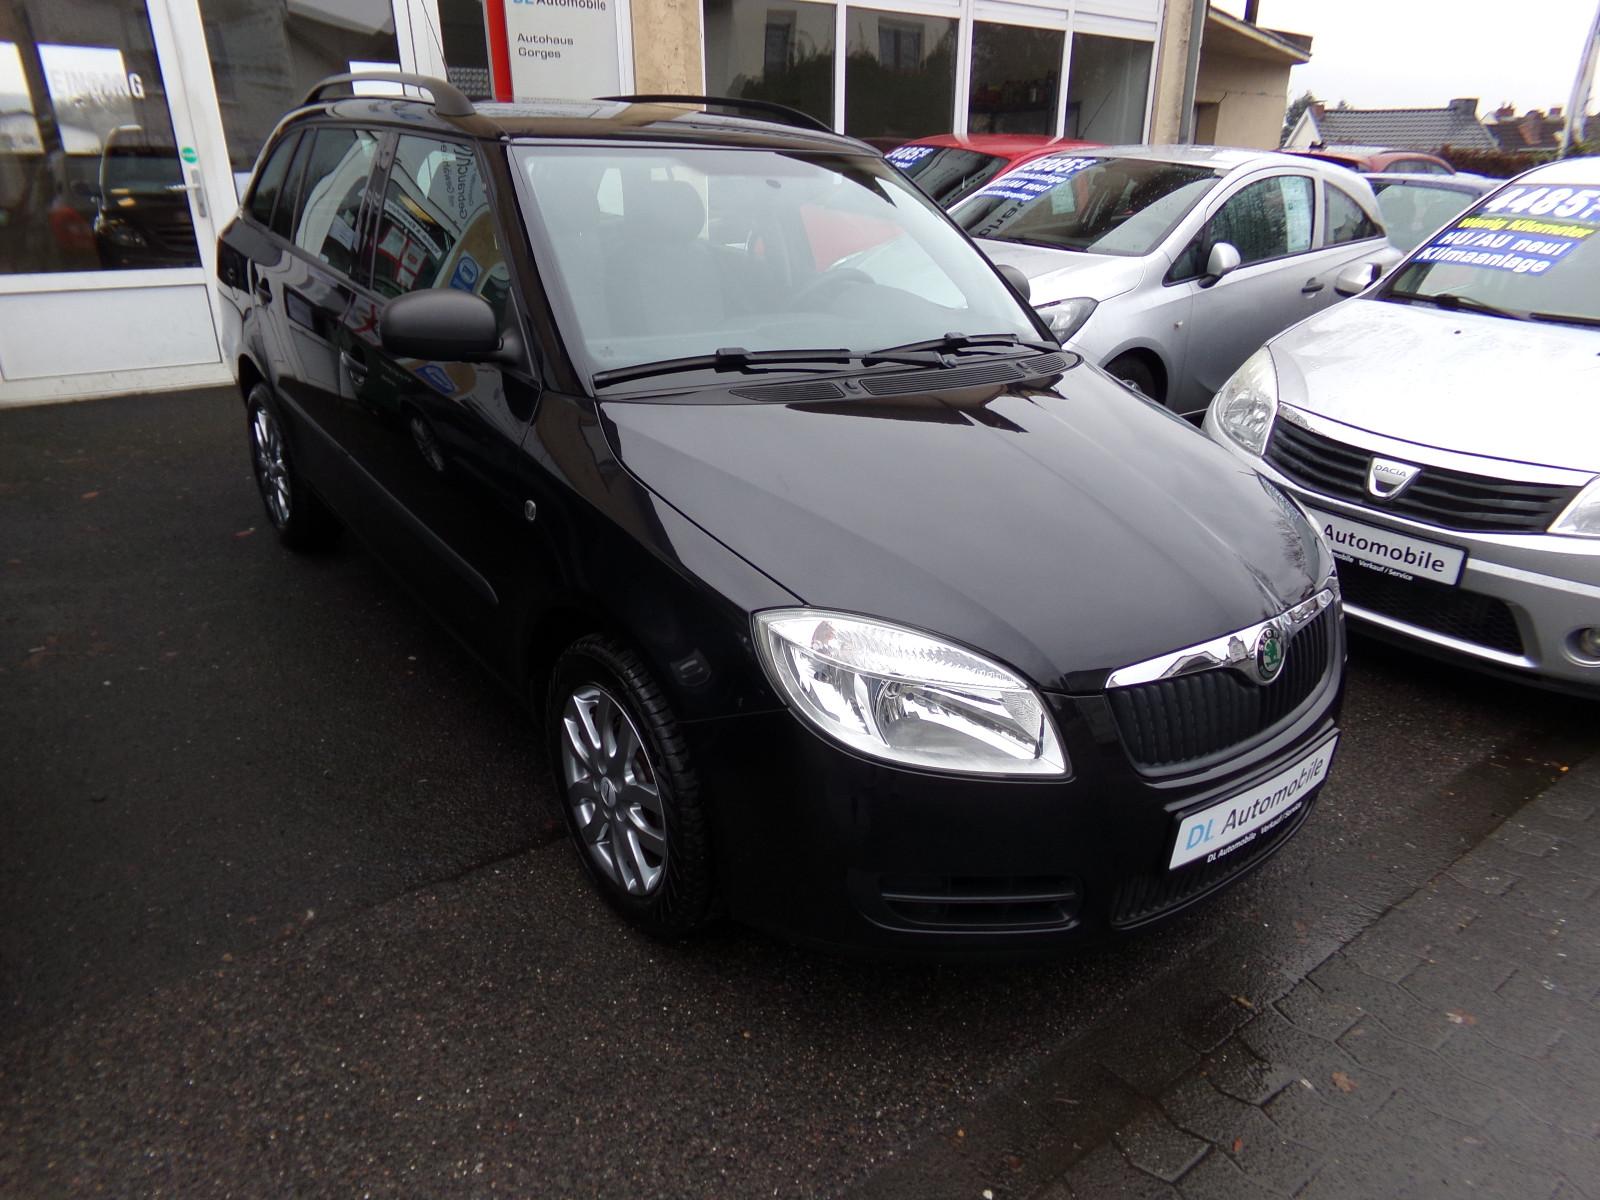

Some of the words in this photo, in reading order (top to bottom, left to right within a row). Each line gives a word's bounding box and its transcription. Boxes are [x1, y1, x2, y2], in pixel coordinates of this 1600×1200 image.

[517, 33, 573, 45] Autohaus
[518, 47, 561, 60] Gorges
[1437, 231, 1514, 248] HU/AU
[1510, 240, 1572, 256] neu!
[1415, 247, 1551, 273] Klimaanlage
[1375, 464, 1407, 477] DACIA
[1324, 524, 1445, 572] Automobile
[1186, 819, 1213, 850] DL
[1220, 758, 1323, 835] Automobile
[1207, 852, 1217, 863] DL
[1218, 832, 1257, 858] Automobile
